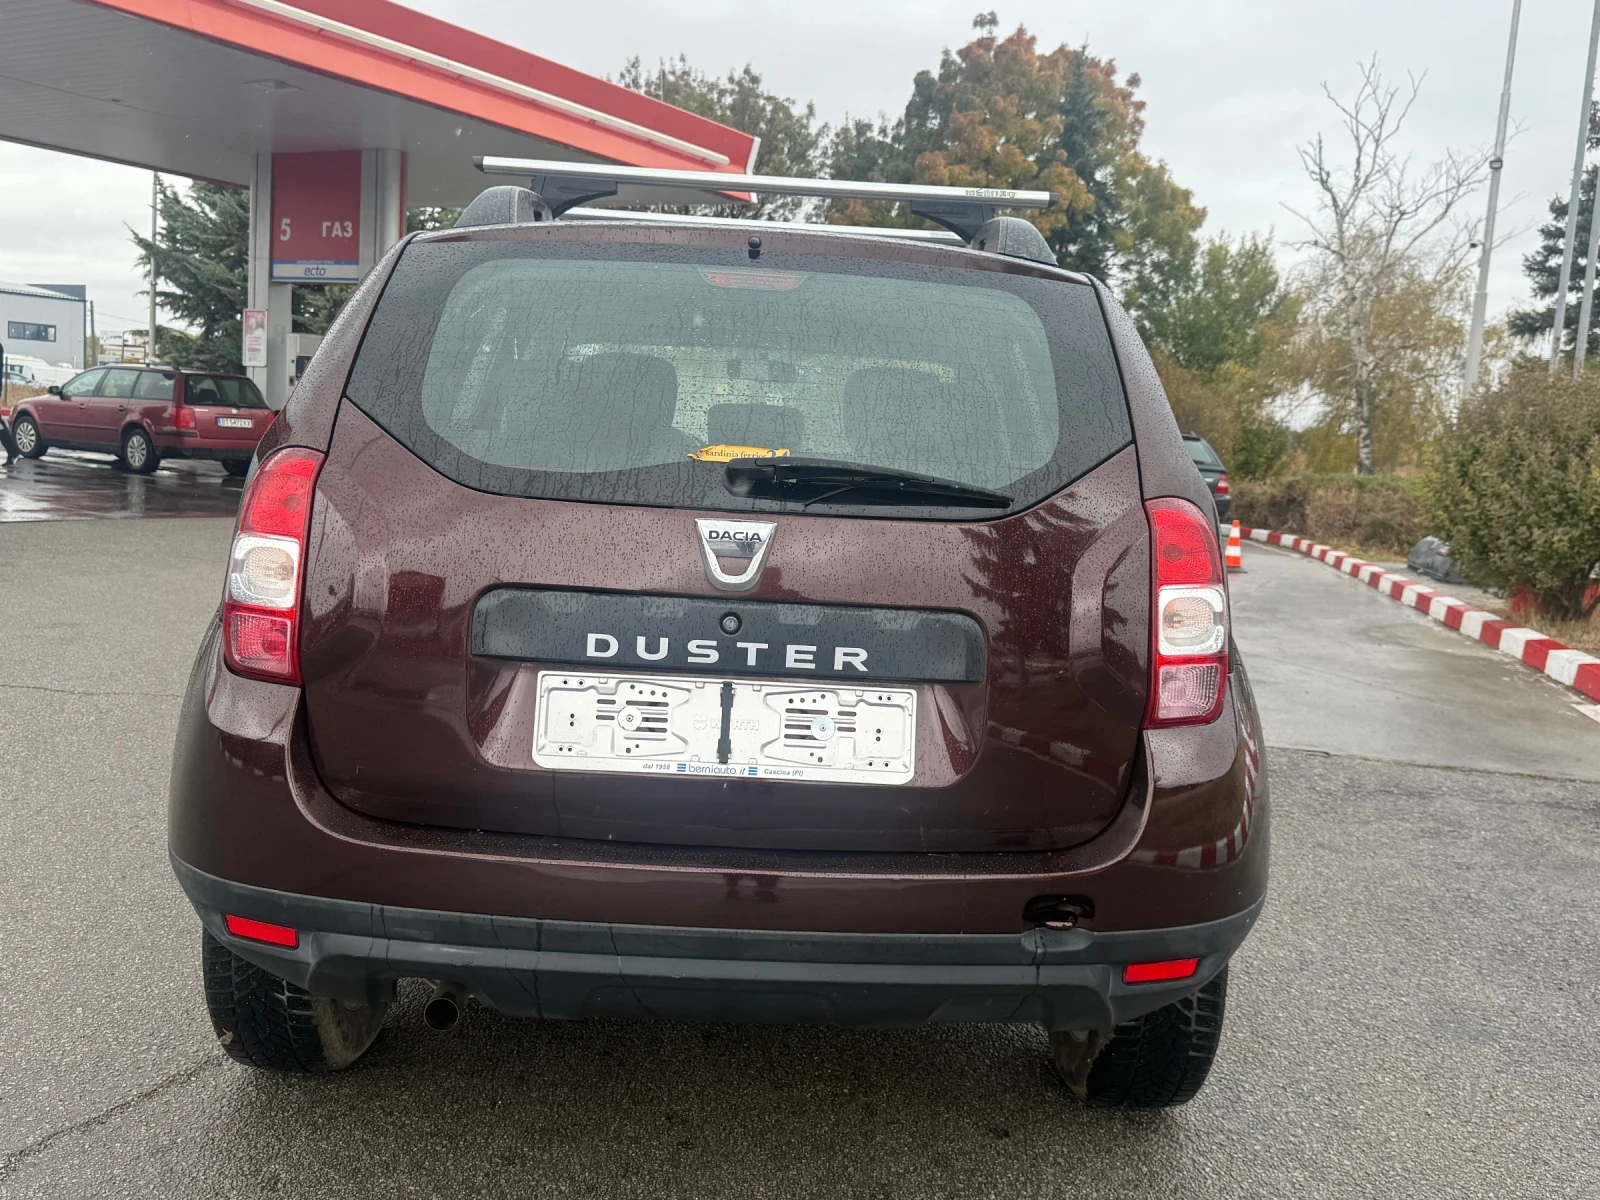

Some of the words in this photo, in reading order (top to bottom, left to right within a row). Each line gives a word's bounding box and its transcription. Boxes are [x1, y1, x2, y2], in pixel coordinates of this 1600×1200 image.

[280, 218, 292, 241] 5
[322, 221, 353, 238] ГАЗ
[304, 266, 326, 276] ecto
[706, 450, 739, 458] sardinia
[708, 530, 763, 543] DACIA
[586, 633, 869, 672] DUSTER
[710, 718, 760, 731] WRTH
